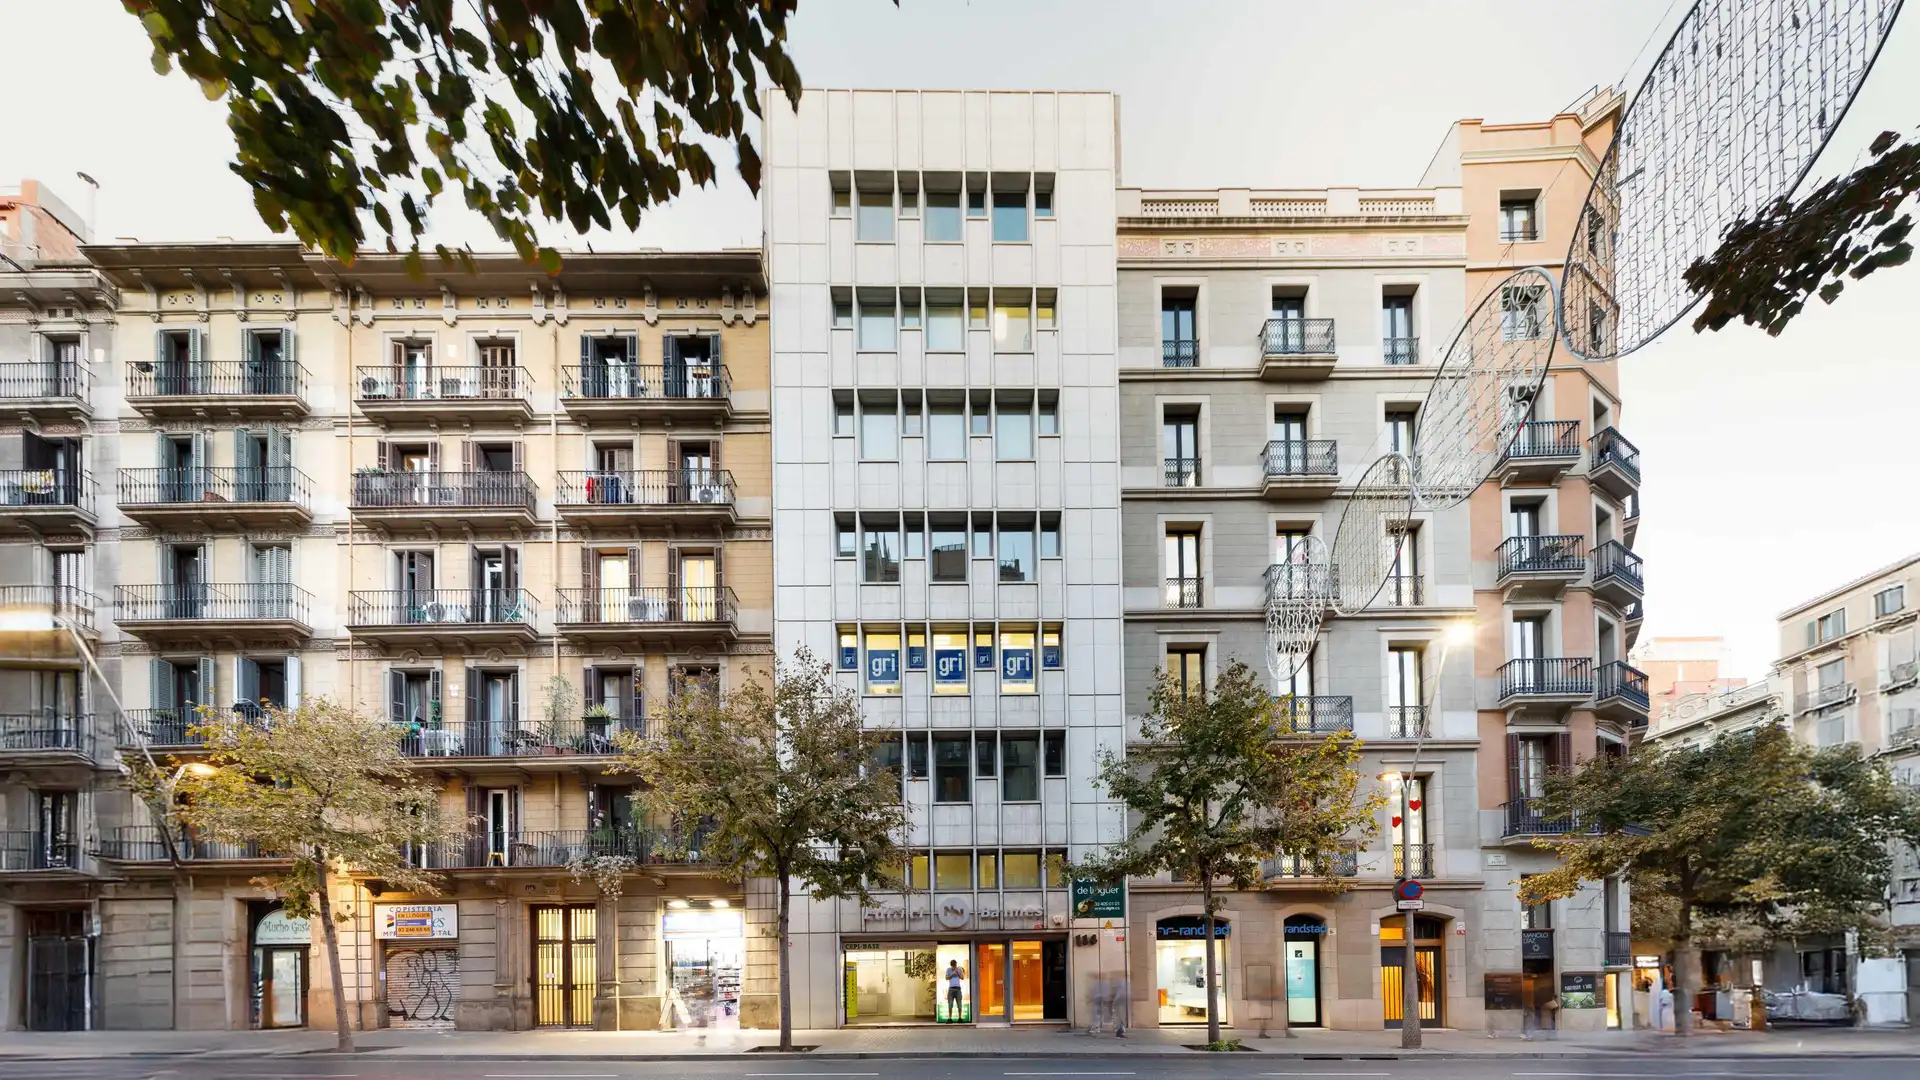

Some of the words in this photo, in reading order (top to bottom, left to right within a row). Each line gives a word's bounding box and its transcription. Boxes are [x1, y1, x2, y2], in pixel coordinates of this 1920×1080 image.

[913, 655, 922, 664] gri
[939, 652, 963, 677] gri
[980, 654, 989, 663] gri
[1006, 652, 1030, 676] gri
[872, 653, 896, 677] gri
[1077, 886, 1088, 895] de
[262, 920, 290, 933] Mucho
[1284, 923, 1328, 934] randstad
